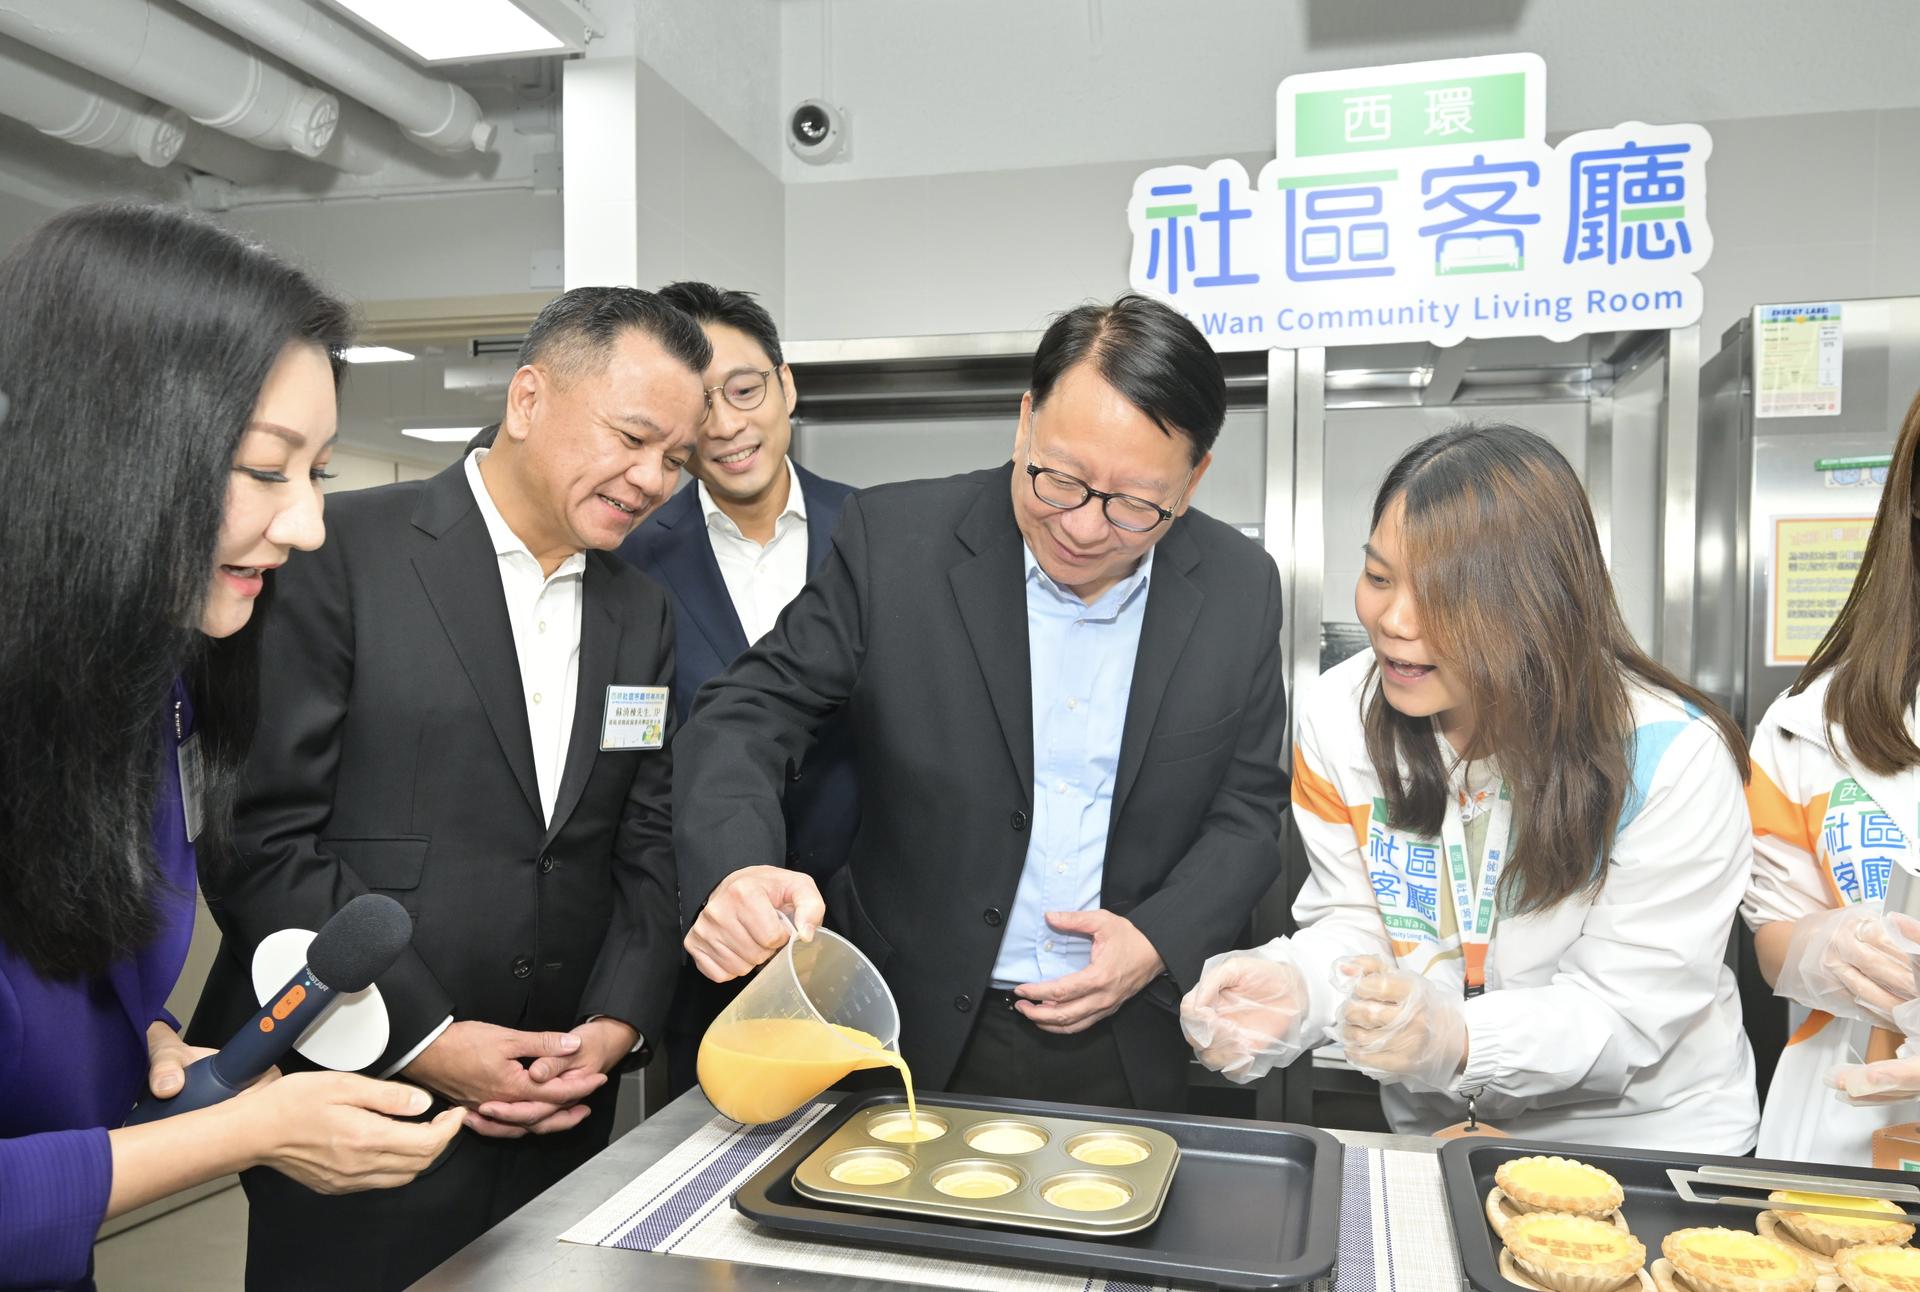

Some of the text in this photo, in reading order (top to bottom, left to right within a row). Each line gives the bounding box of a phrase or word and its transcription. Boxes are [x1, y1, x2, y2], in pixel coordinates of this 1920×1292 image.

[1343, 86, 1476, 144] 西環
[1145, 141, 1693, 295] 社區客廳
[1202, 289, 1683, 335] Wan Community Living Room
[1369, 827, 1440, 879] 社區
[1824, 811, 1906, 856] 社區
[1370, 870, 1437, 921] 客廳
[1386, 915, 1426, 930] Sai Wan
